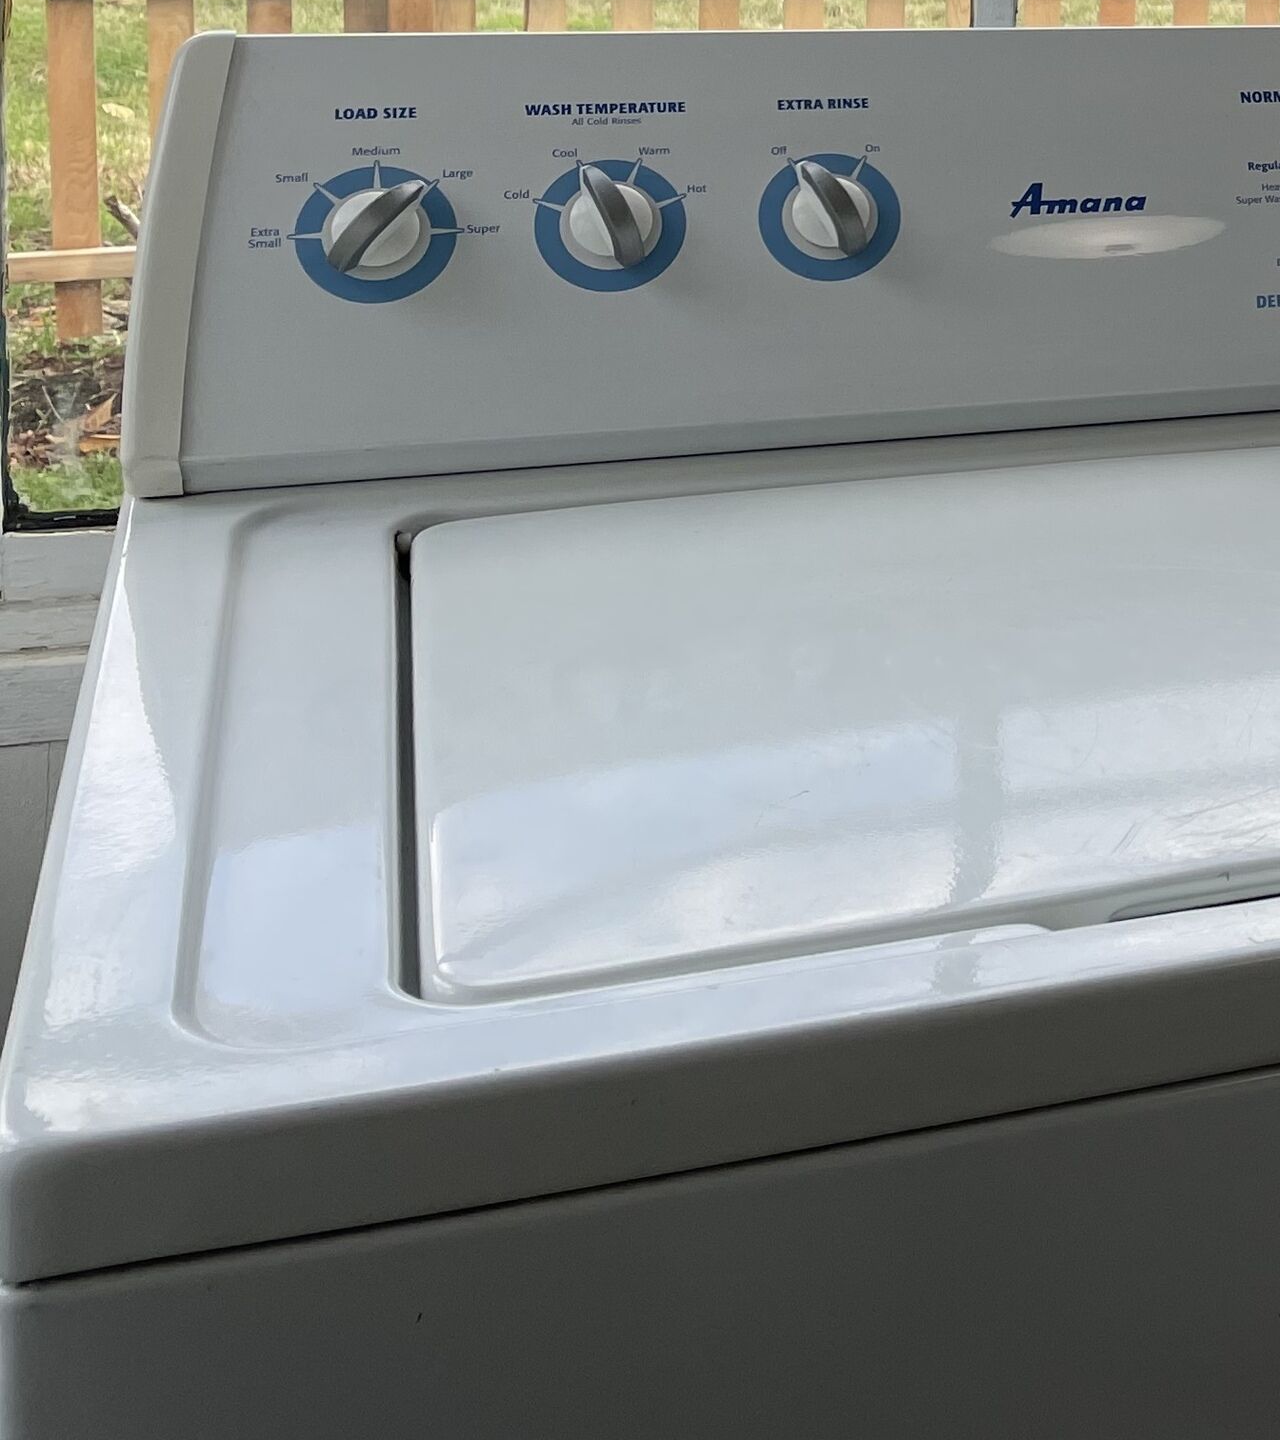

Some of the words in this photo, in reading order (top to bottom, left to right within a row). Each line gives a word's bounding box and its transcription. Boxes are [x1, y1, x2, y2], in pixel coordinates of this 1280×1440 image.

[525, 103, 573, 117] WASH
[577, 101, 686, 116] TEMPERATURE
[777, 98, 824, 111] EXTRA
[827, 97, 869, 110] RINSE
[334, 106, 378, 120] LOAD
[383, 105, 417, 119] SIZE
[586, 117, 608, 125] Cold
[611, 117, 642, 125] Rinses
[352, 146, 401, 157] Medium
[552, 148, 578, 159] Cool
[639, 145, 671, 157] Warm
[771, 146, 787, 156] Off
[865, 144, 880, 154] On
[275, 172, 308, 184] Small
[443, 168, 473, 180] Large
[504, 189, 530, 200] Cold
[687, 183, 707, 194] Hot
[1010, 183, 1147, 218] Amana
[1236, 195, 1262, 206] Super
[250, 226, 280, 238] Extra
[467, 223, 500, 236] Super
[248, 237, 282, 249] Small
